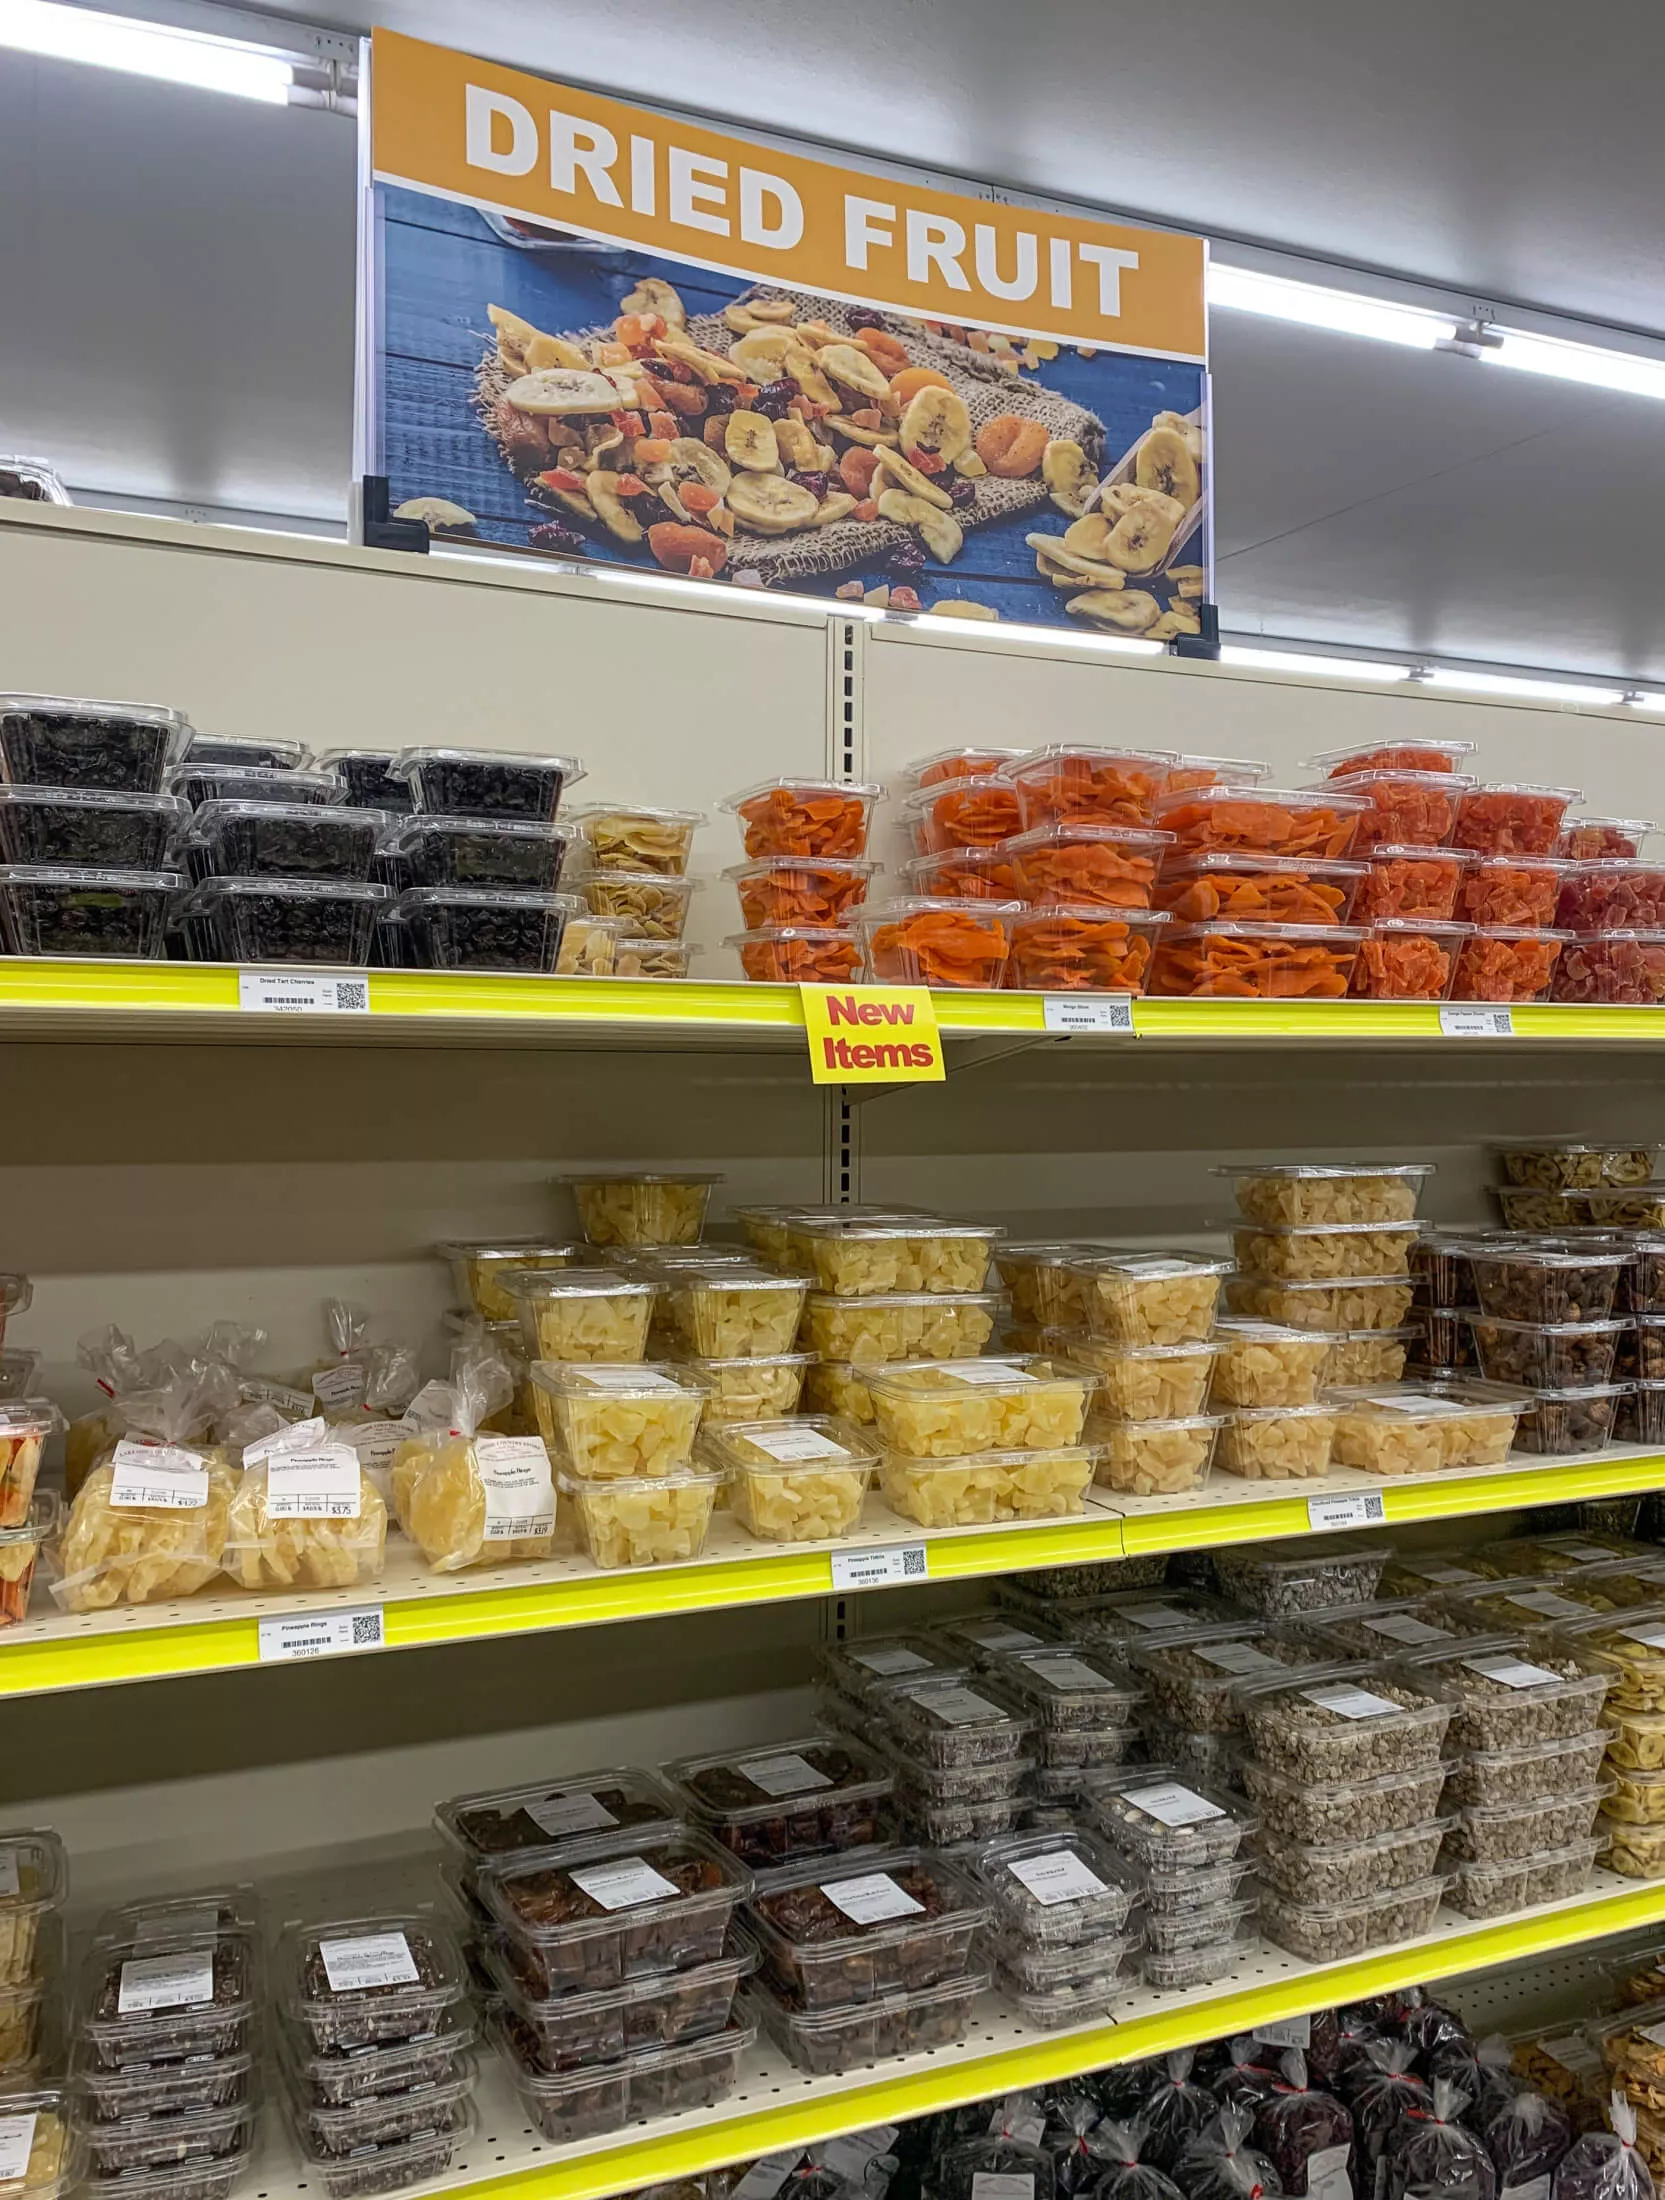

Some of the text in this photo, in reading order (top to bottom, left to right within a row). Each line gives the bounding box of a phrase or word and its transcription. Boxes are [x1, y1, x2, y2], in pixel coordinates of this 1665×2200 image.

[464, 83, 1140, 318] DRIED FRUIT
[826, 995, 915, 1026] New
[823, 1037, 934, 1069] Items
[281, 1621, 328, 1631] Pineapple Rings
